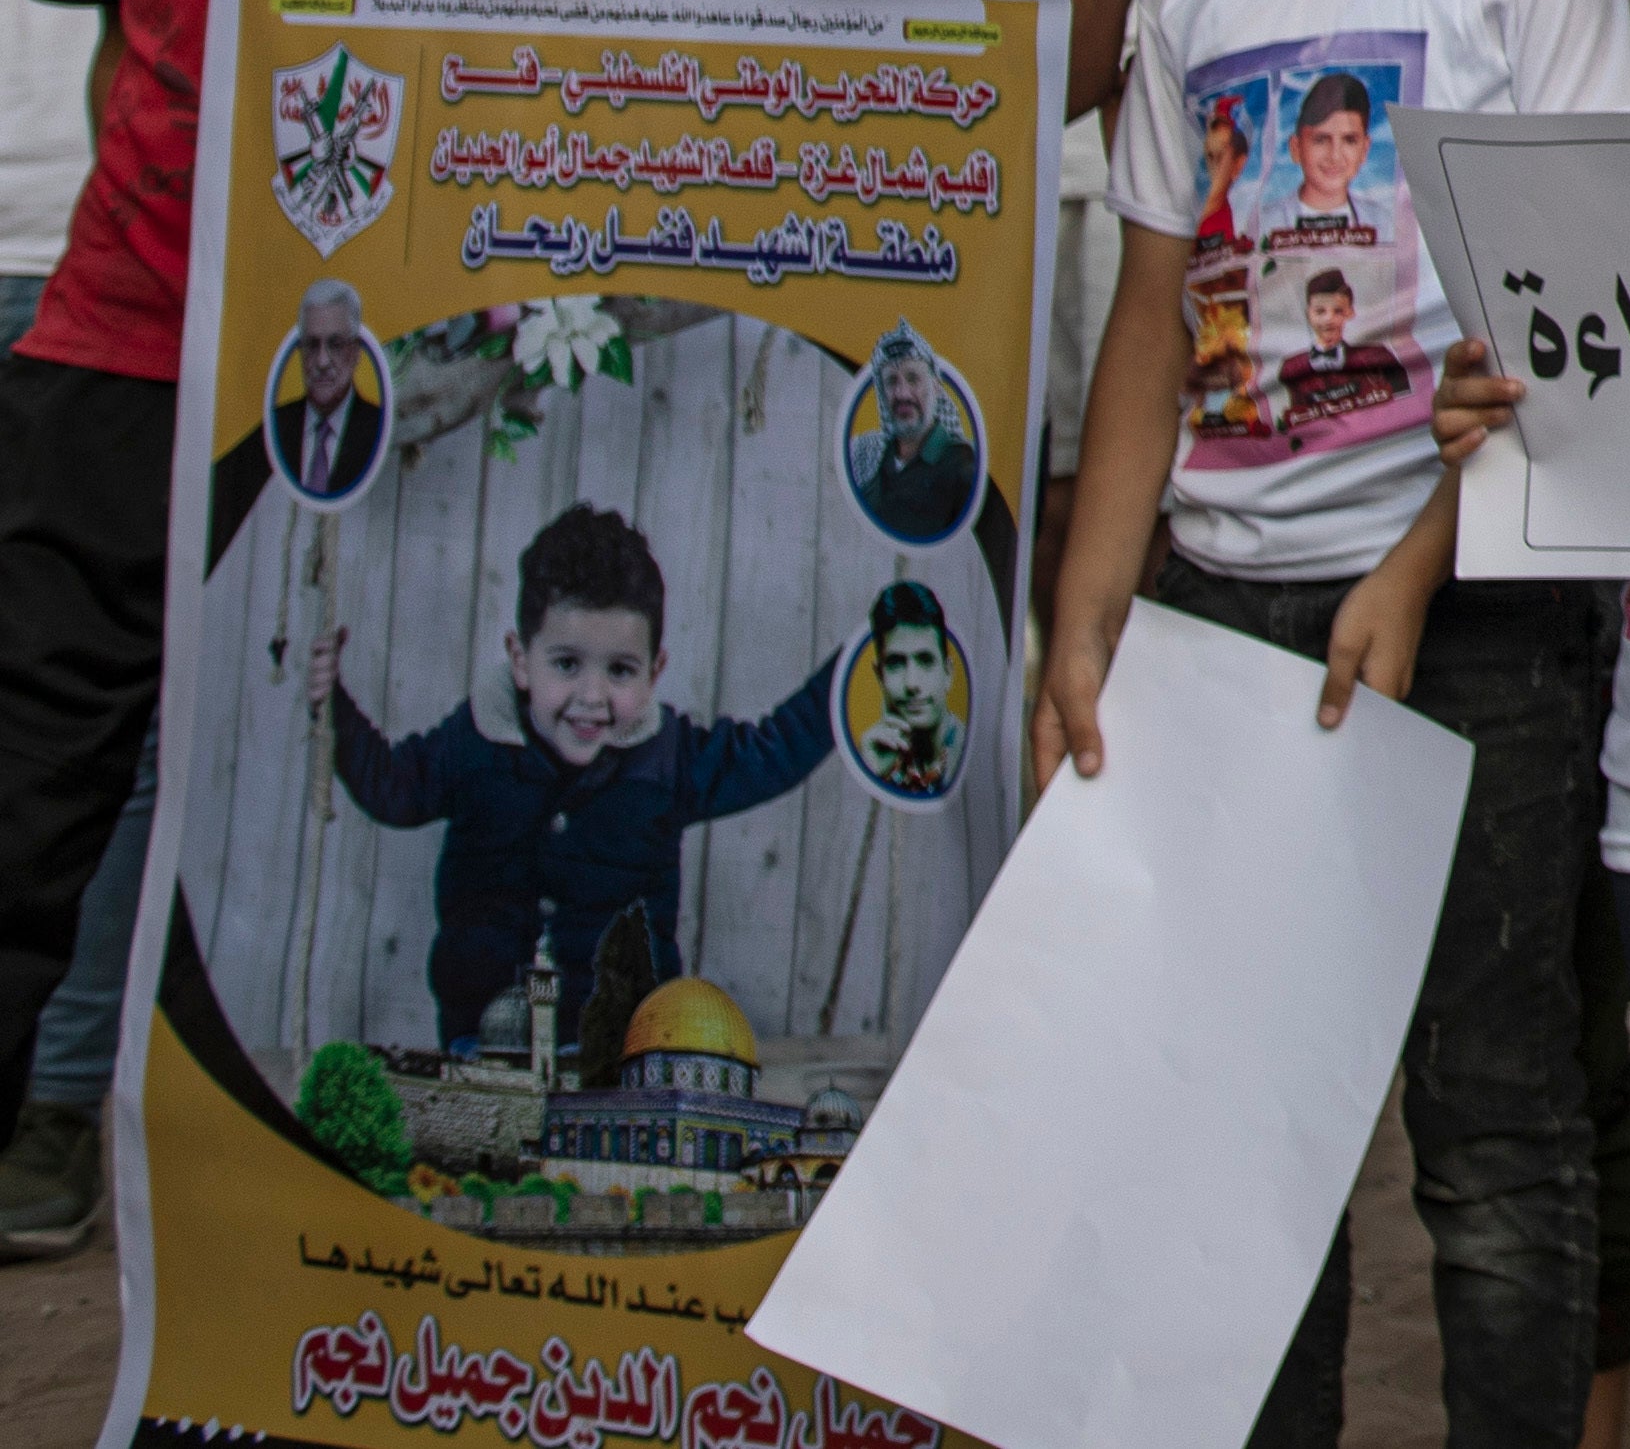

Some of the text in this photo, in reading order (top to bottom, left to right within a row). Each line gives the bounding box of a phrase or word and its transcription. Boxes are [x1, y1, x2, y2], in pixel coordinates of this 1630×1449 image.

[443, 47, 995, 125] حركة التحرير الوطني الفلسطيني فتح
[431, 124, 998, 213] إقليم شمال غزة قلعة الشهيد جمال أبو الجديان
[462, 201, 589, 274] ريحان
[589, 206, 696, 273] فضل
[698, 213, 826, 282] الشهيد
[828, 219, 956, 281] منطقة
[299, 1234, 442, 1285] شهيدها
[445, 1259, 542, 1302] تعالى
[550, 1269, 621, 1309] الله
[632, 1280, 708, 1322] عند
[293, 1311, 391, 1414] نجم
[393, 1316, 535, 1438] جميل
[531, 1339, 679, 1448] الدين
[684, 1367, 786, 1449] نجم
